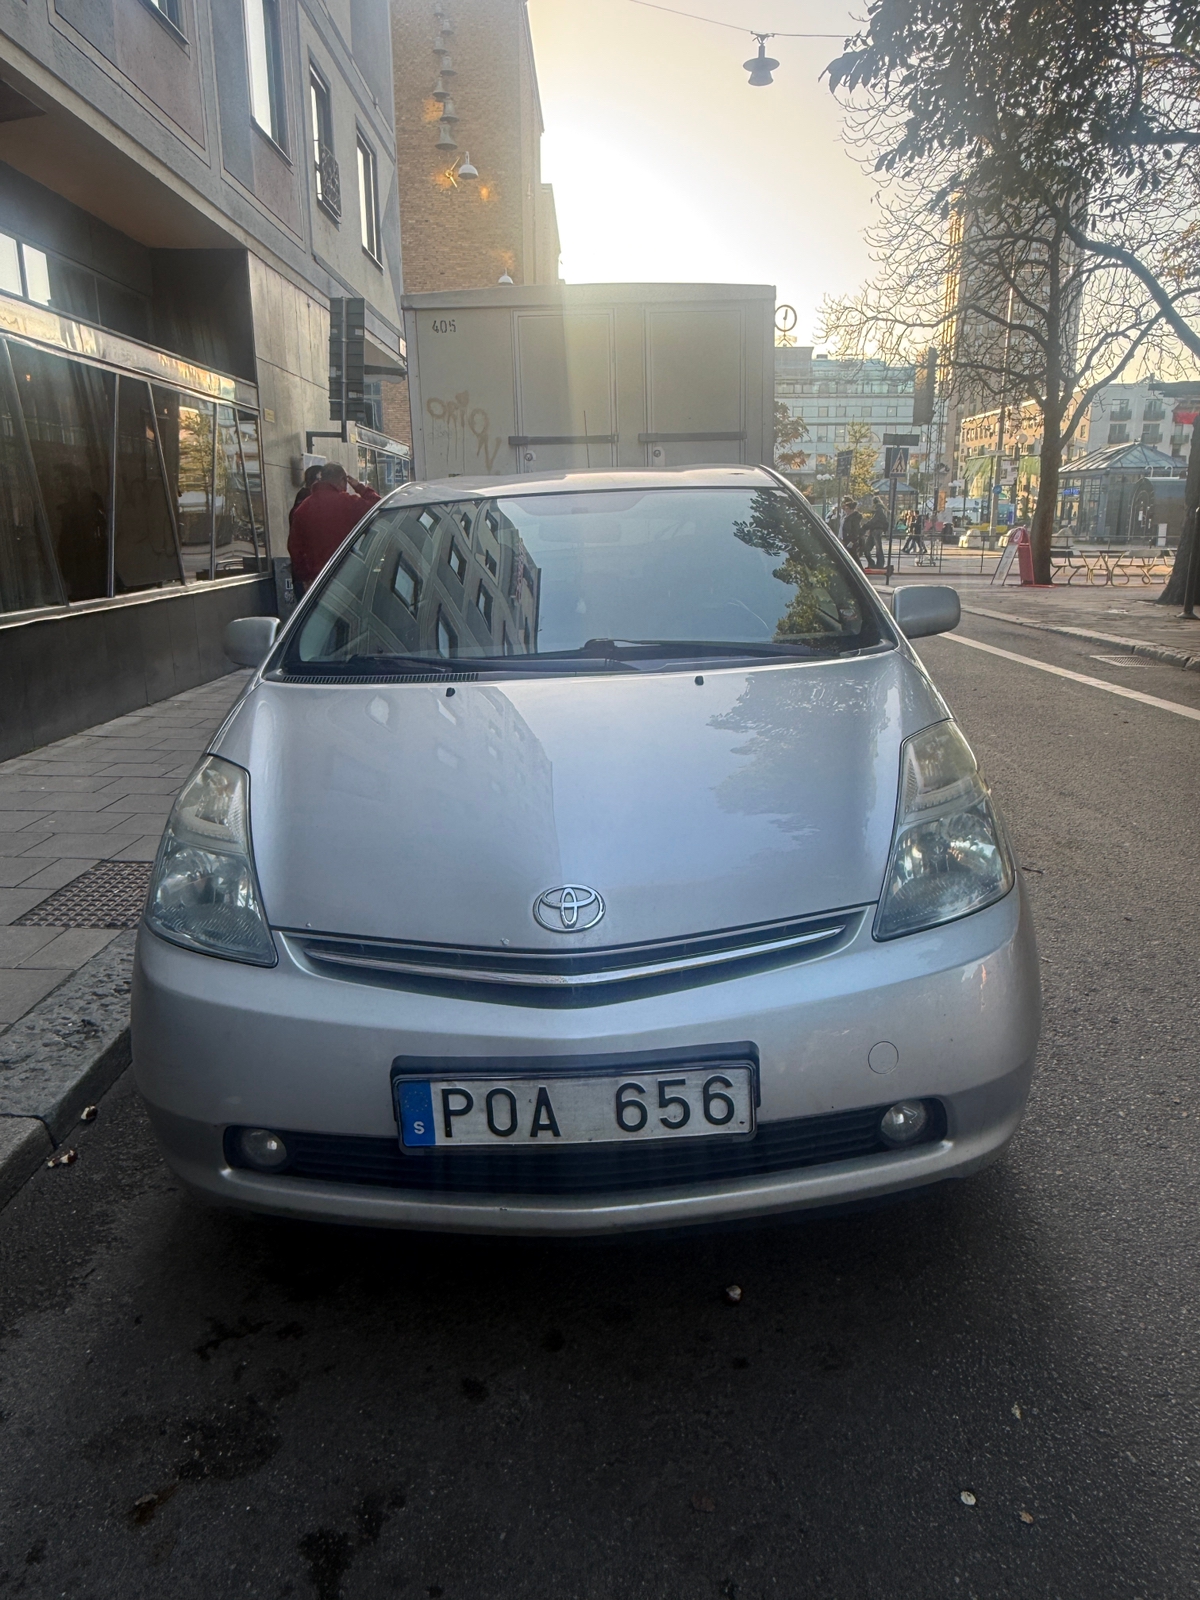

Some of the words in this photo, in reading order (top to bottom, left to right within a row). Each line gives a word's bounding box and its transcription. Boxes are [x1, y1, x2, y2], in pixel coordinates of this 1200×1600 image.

[432, 319, 456, 333] 405
[441, 1086, 562, 1138] POA
[615, 1075, 735, 1133] 656
[413, 1121, 425, 1135] S
